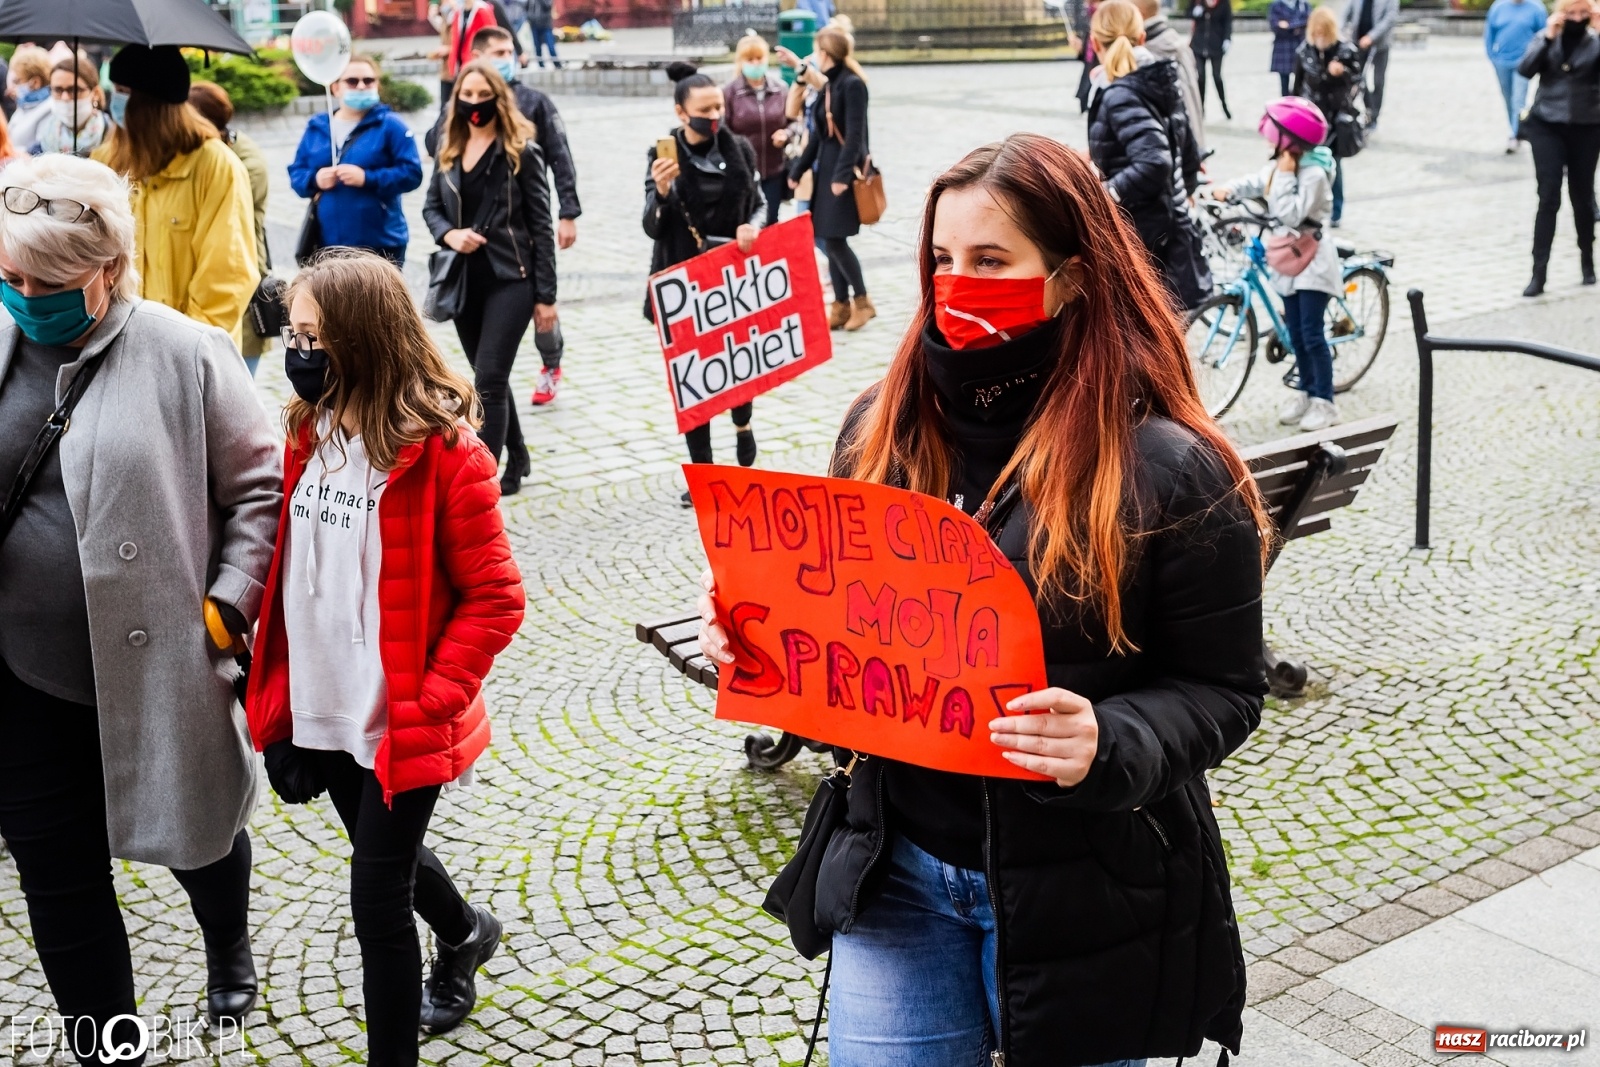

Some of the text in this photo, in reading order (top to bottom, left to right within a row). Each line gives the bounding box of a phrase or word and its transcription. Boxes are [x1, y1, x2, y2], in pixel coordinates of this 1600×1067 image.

[655, 260, 788, 345] Piekło
[673, 319, 802, 408] Kobiet
[320, 506, 337, 525] do
[341, 512, 351, 529] it
[708, 480, 873, 595] MOJE
[846, 580, 999, 678] MOJA
